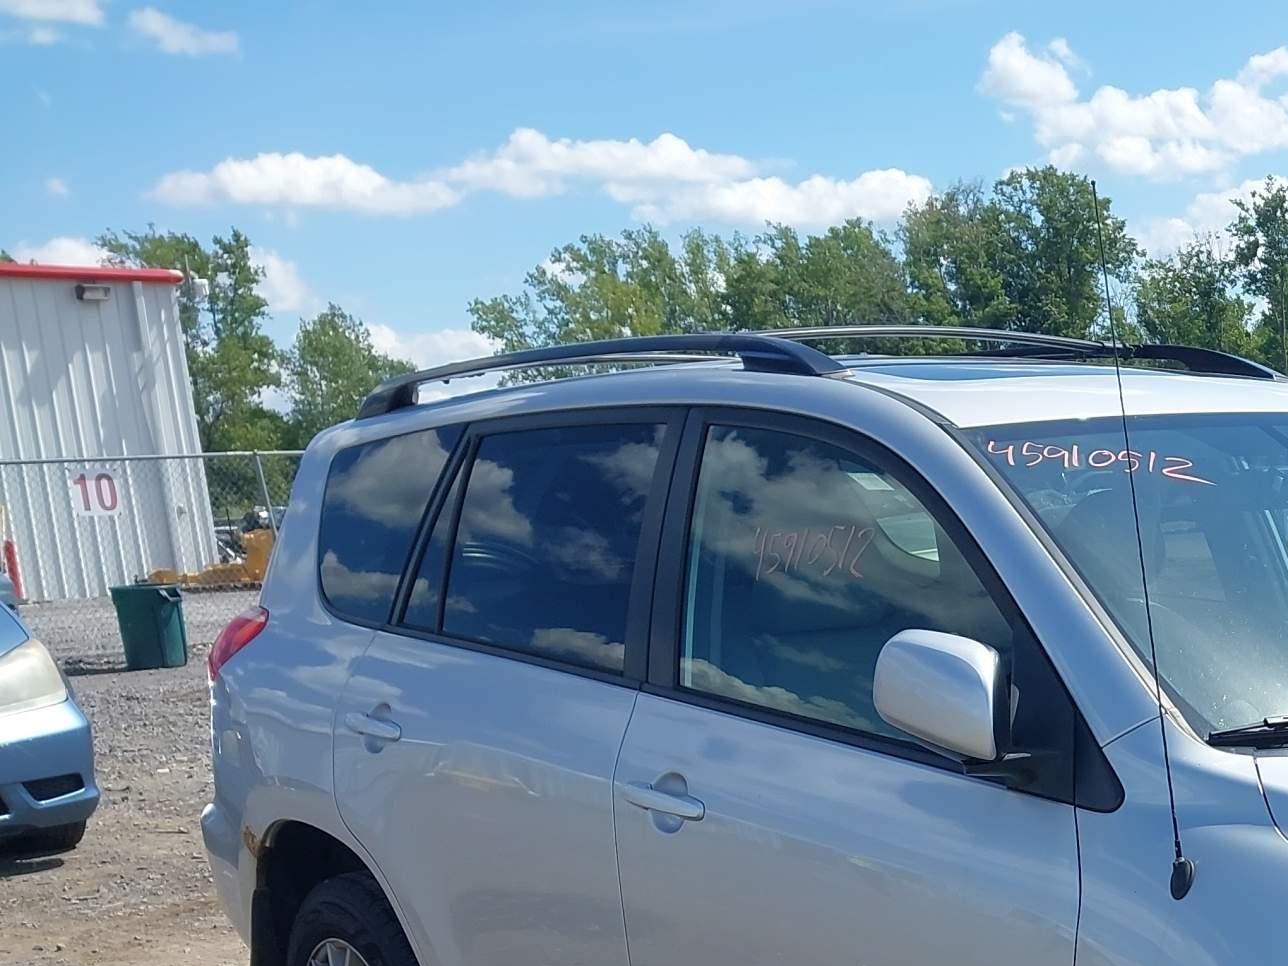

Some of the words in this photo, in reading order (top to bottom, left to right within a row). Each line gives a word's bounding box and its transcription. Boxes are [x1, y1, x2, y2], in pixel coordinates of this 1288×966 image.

[987, 439, 1217, 487] 45910512
[72, 471, 119, 513] 10
[752, 525, 876, 582] 45910512
